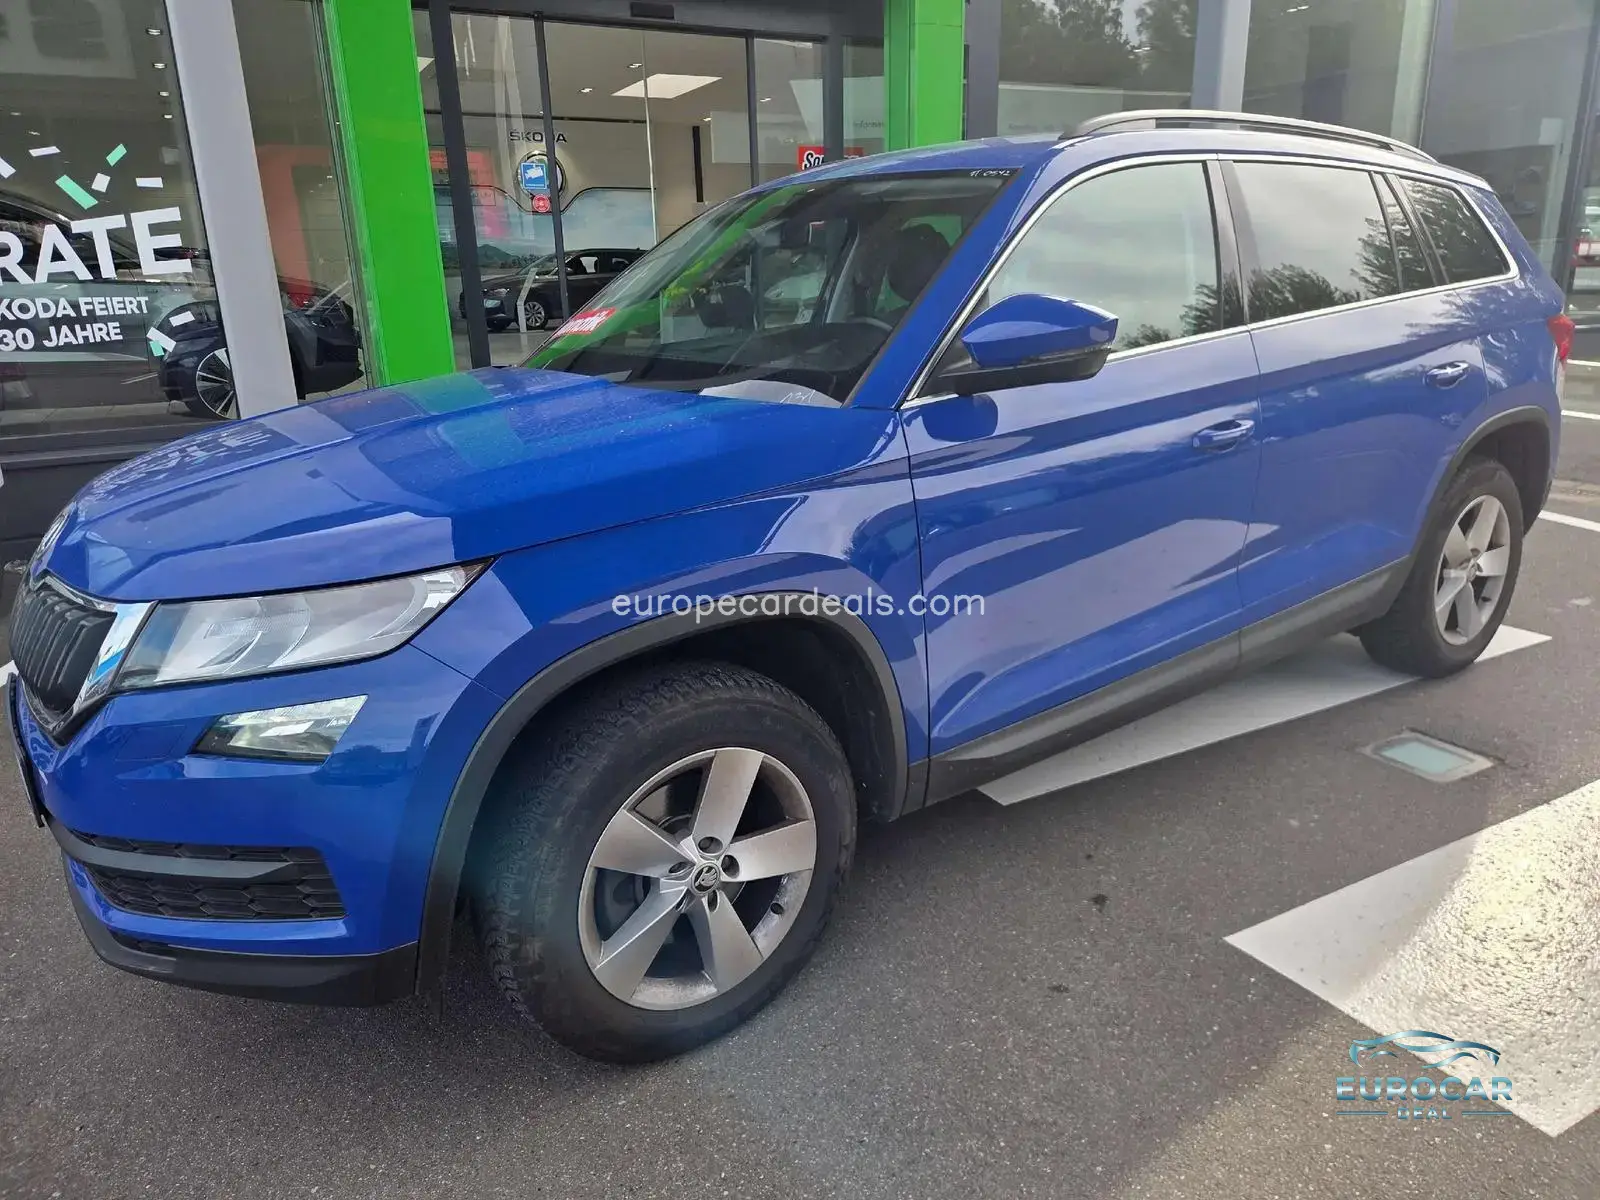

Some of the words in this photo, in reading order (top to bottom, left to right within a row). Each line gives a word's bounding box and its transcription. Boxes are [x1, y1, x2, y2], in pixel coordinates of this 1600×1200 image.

[509, 128, 567, 143] ŠKOA
[0, 206, 193, 286] RATE
[79, 296, 149, 317] FEIERT
[0, 328, 35, 352] 30
[43, 322, 123, 348] JAHRE
